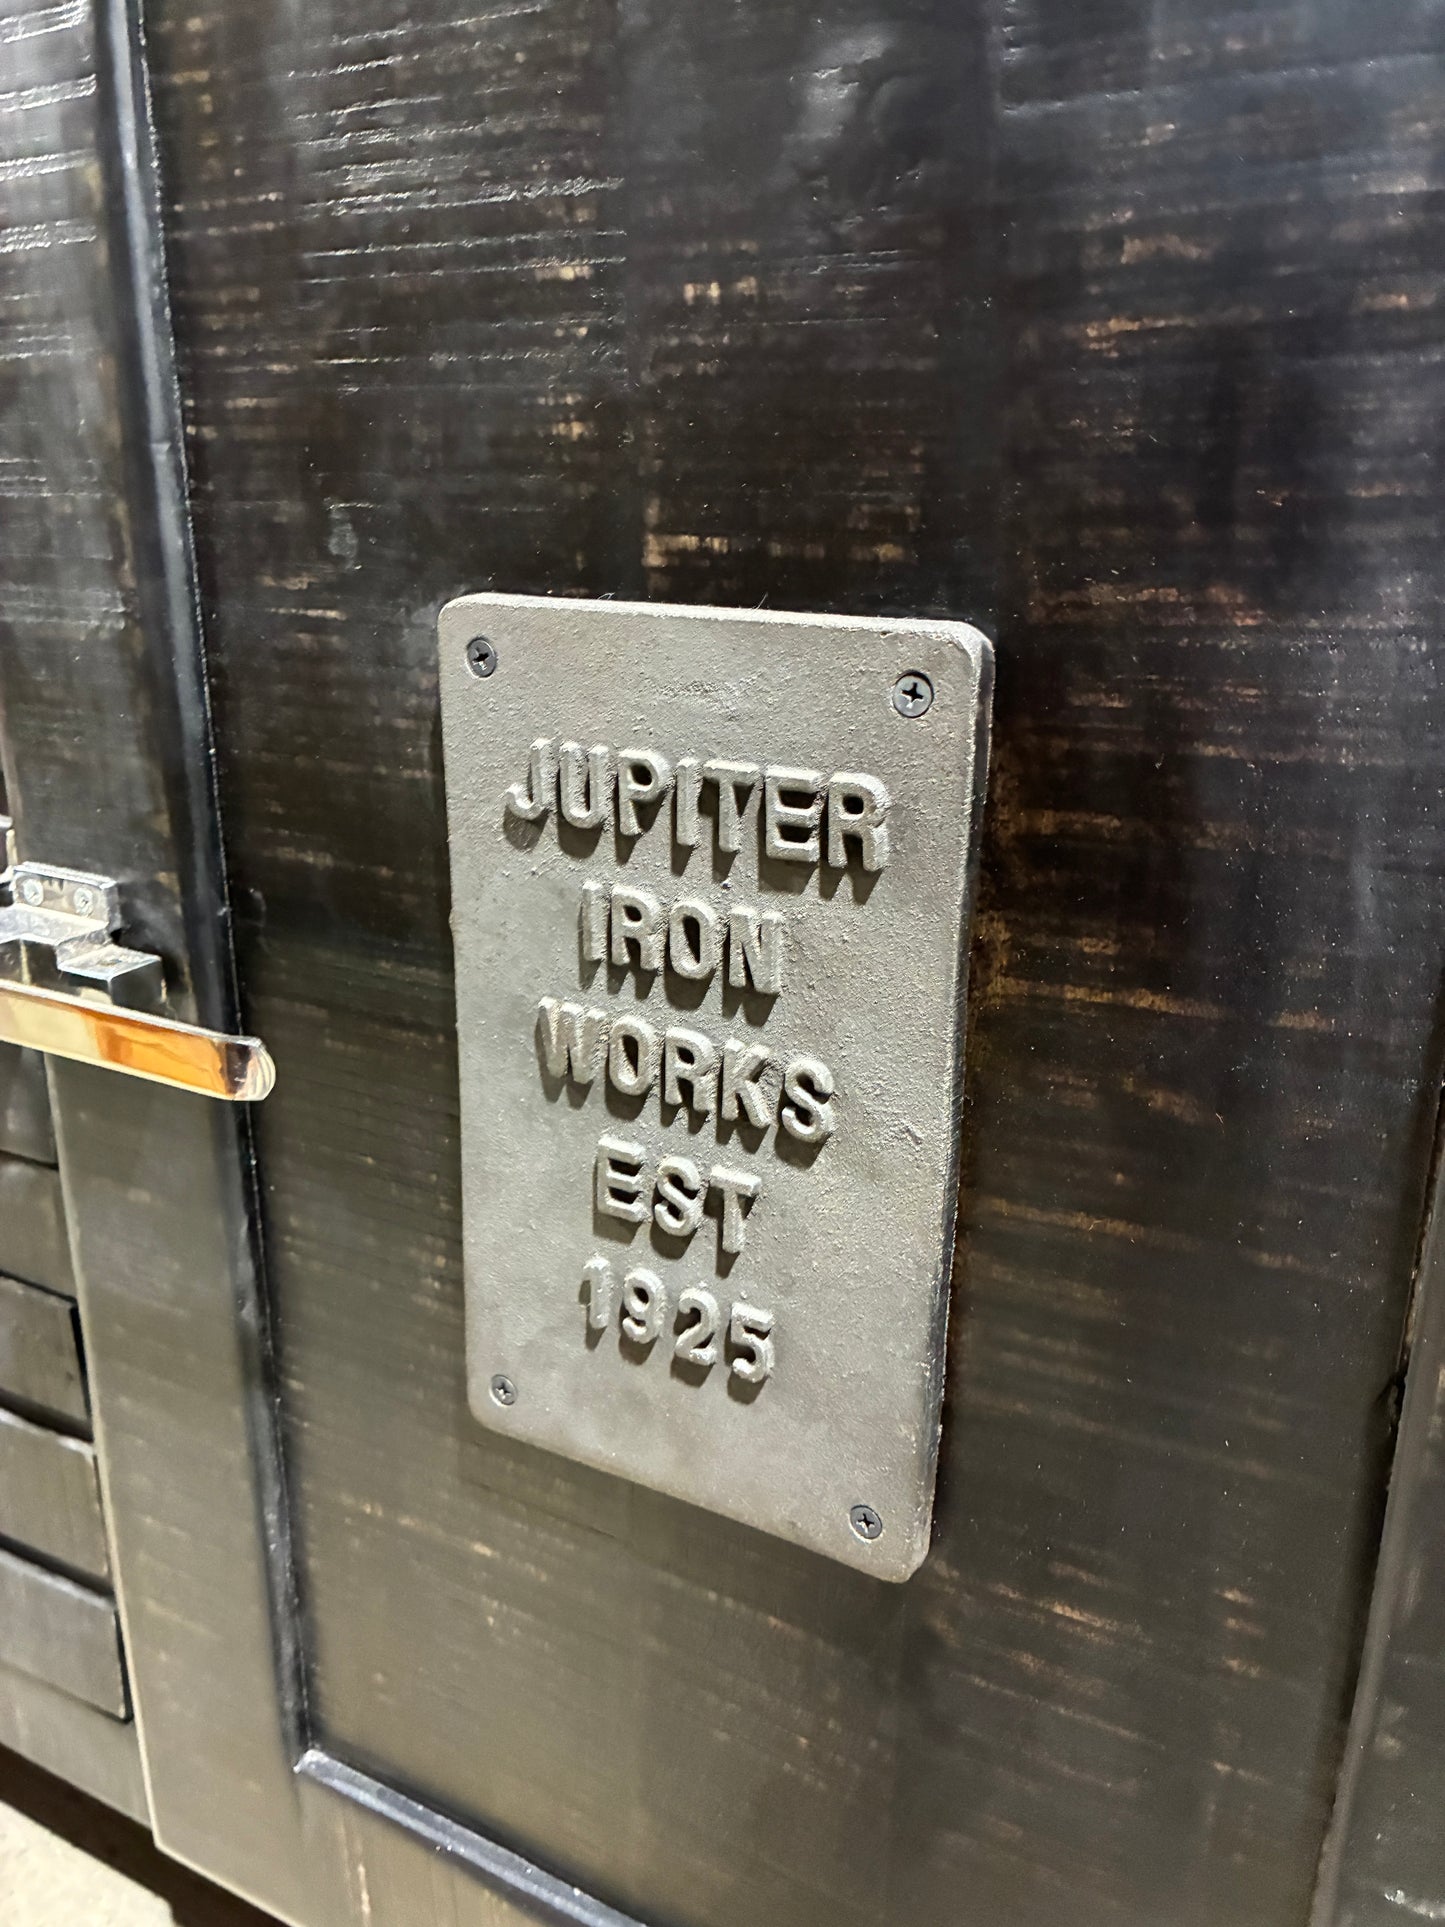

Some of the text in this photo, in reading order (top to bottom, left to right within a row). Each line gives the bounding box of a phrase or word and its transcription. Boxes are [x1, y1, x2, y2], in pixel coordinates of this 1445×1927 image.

[503, 737, 891, 872] JUPITER
[580, 879, 785, 995] IRON
[536, 996, 836, 1143] WORKS
[596, 1134, 763, 1254] EST
[581, 1255, 776, 1383] 1925
